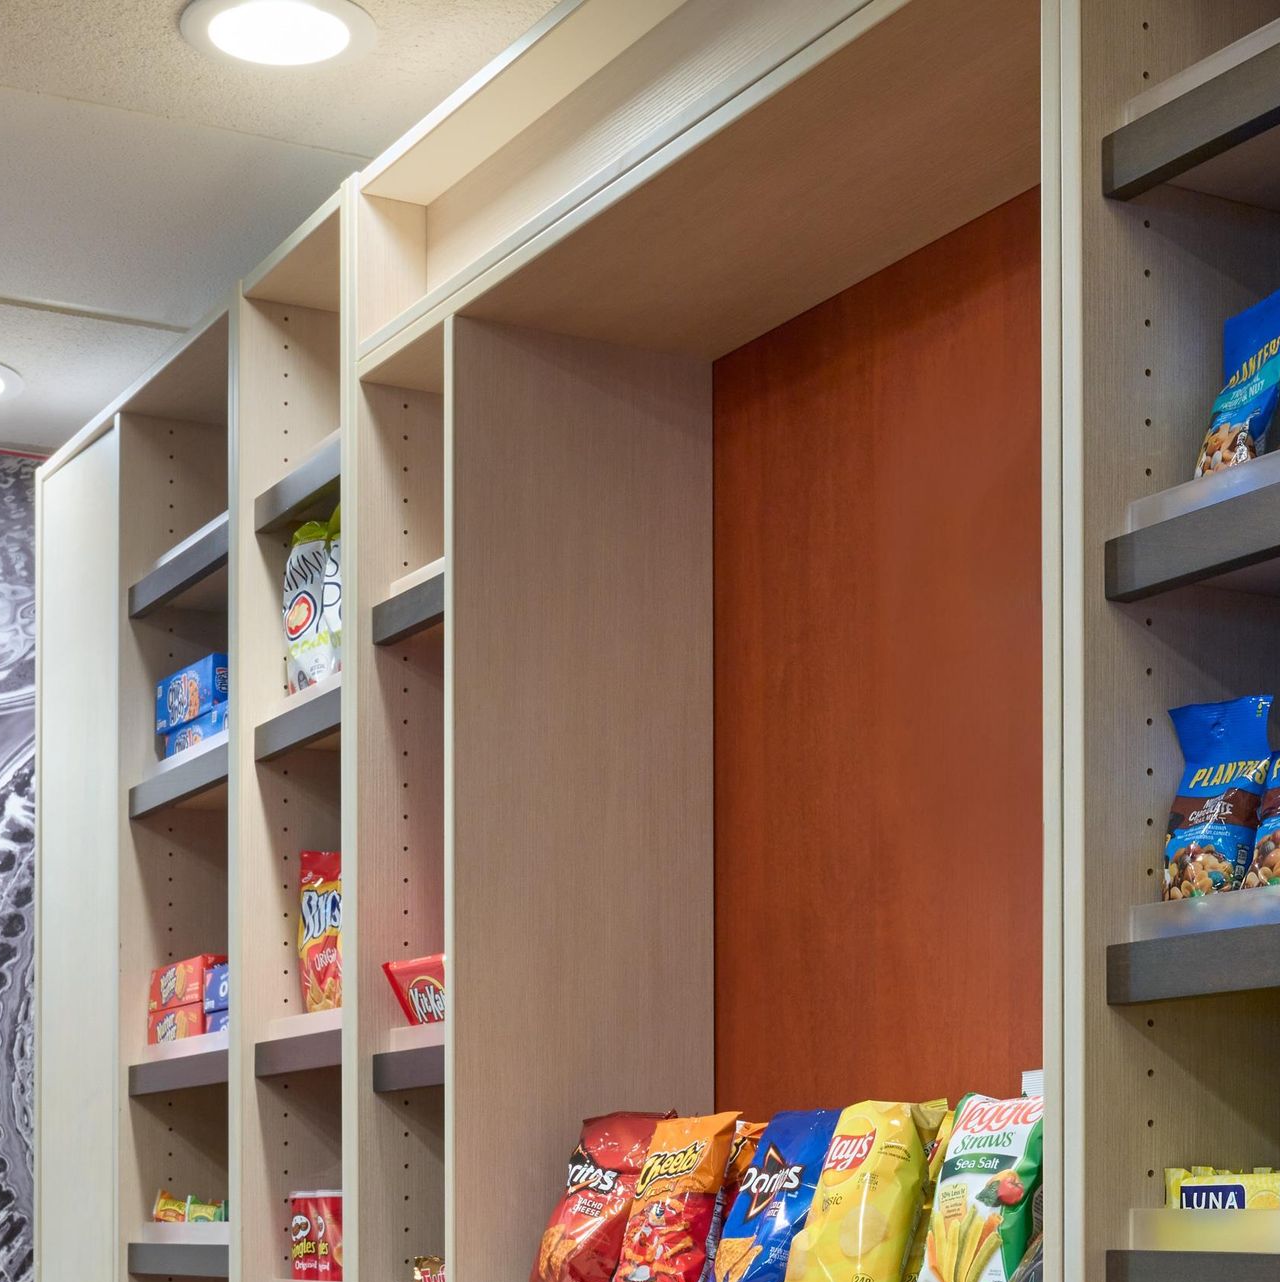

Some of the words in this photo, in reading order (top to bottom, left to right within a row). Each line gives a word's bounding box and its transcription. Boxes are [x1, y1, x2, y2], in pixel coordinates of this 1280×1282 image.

[302, 889, 341, 947] BUG
[953, 1096, 1043, 1139] Veggie
[824, 1132, 875, 1170] Lay's
[954, 1131, 1014, 1154] Straws
[567, 1161, 618, 1191] ritos
[954, 1157, 976, 1171] Sea
[977, 1156, 1000, 1170] Salt
[739, 1165, 804, 1193] Doritos
[1182, 1191, 1239, 1209] LUNA
